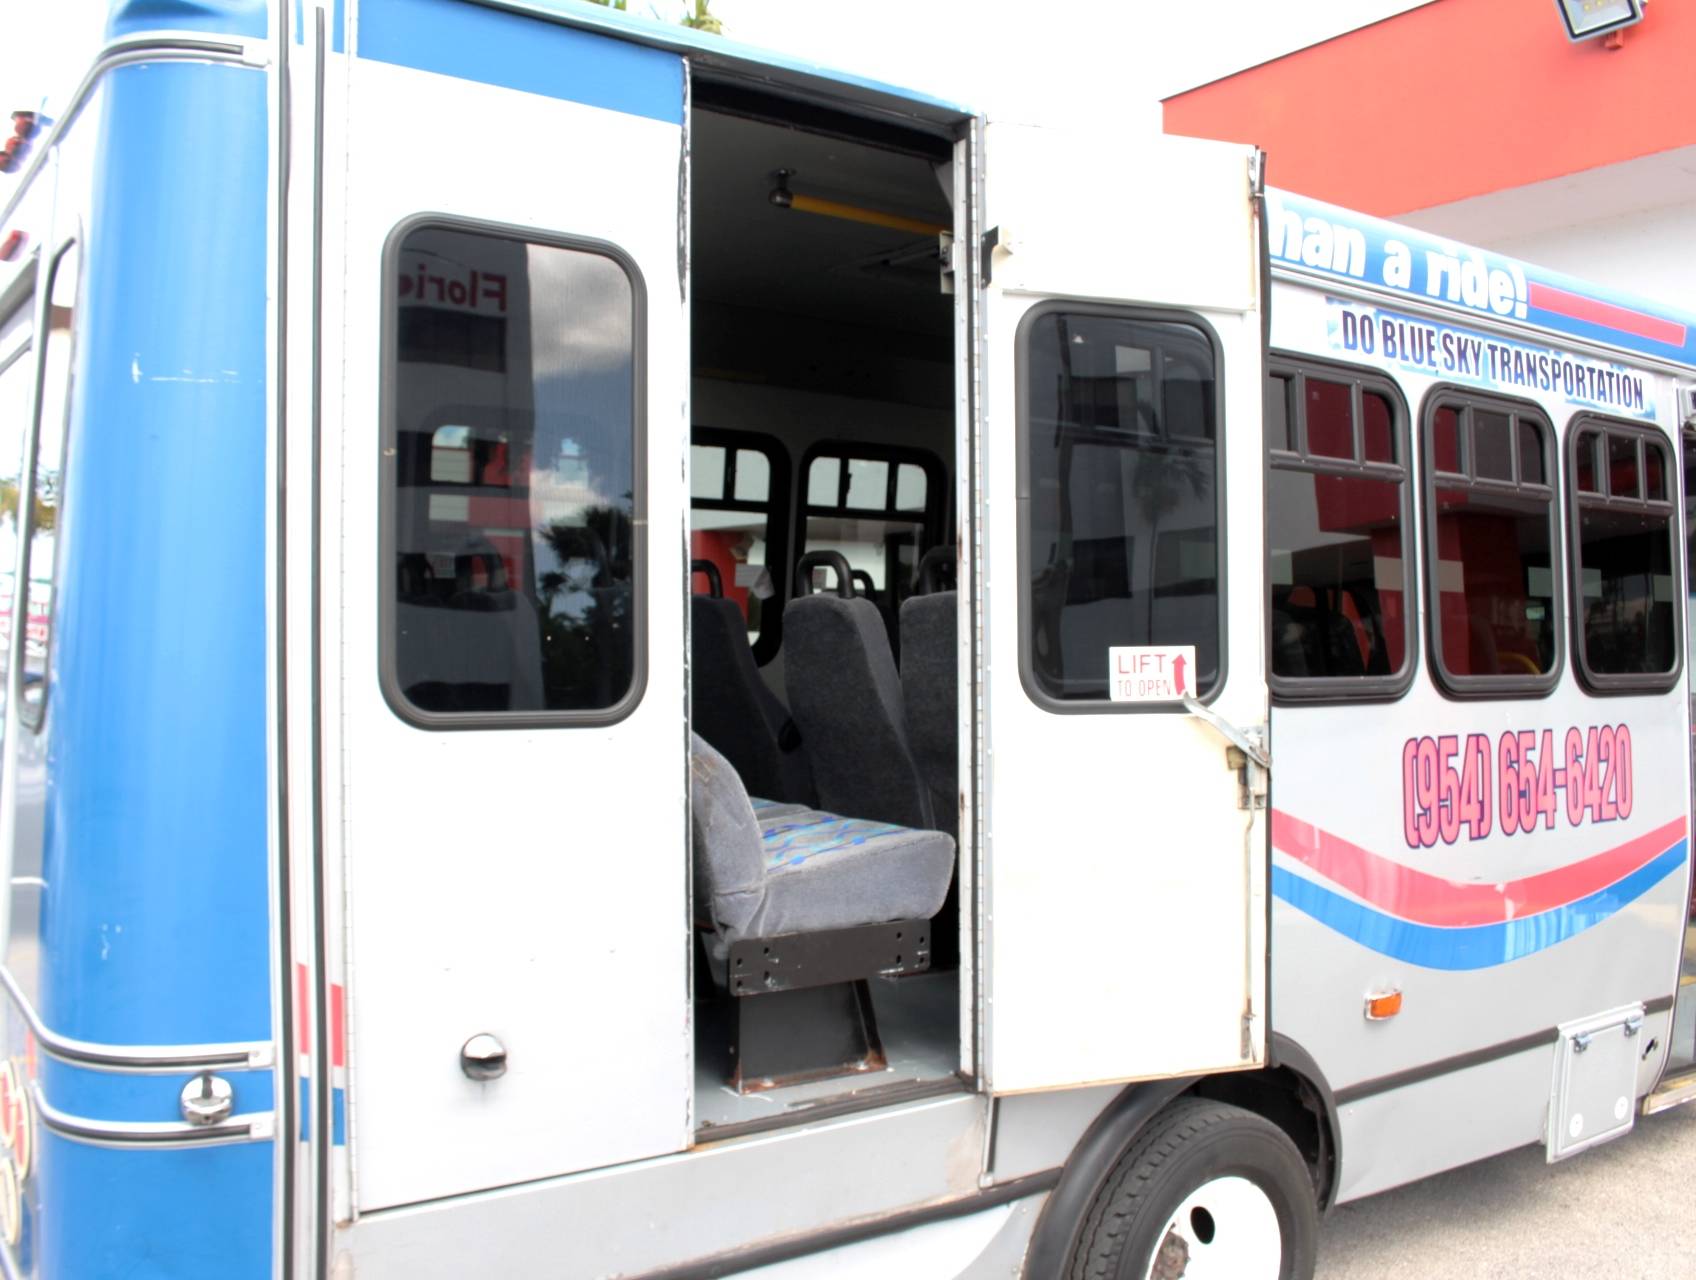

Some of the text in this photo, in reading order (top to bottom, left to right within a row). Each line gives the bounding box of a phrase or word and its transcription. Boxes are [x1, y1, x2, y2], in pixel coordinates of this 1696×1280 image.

[1382, 239, 1411, 289] a
[1425, 242, 1528, 320] ride!
[1342, 310, 1644, 410] DO BLUE SKY TRANSPORTATION
[1118, 654, 1167, 674] LIFT
[1118, 679, 1171, 697] TO OPEN
[1402, 723, 1633, 849] (954) 654-6420
